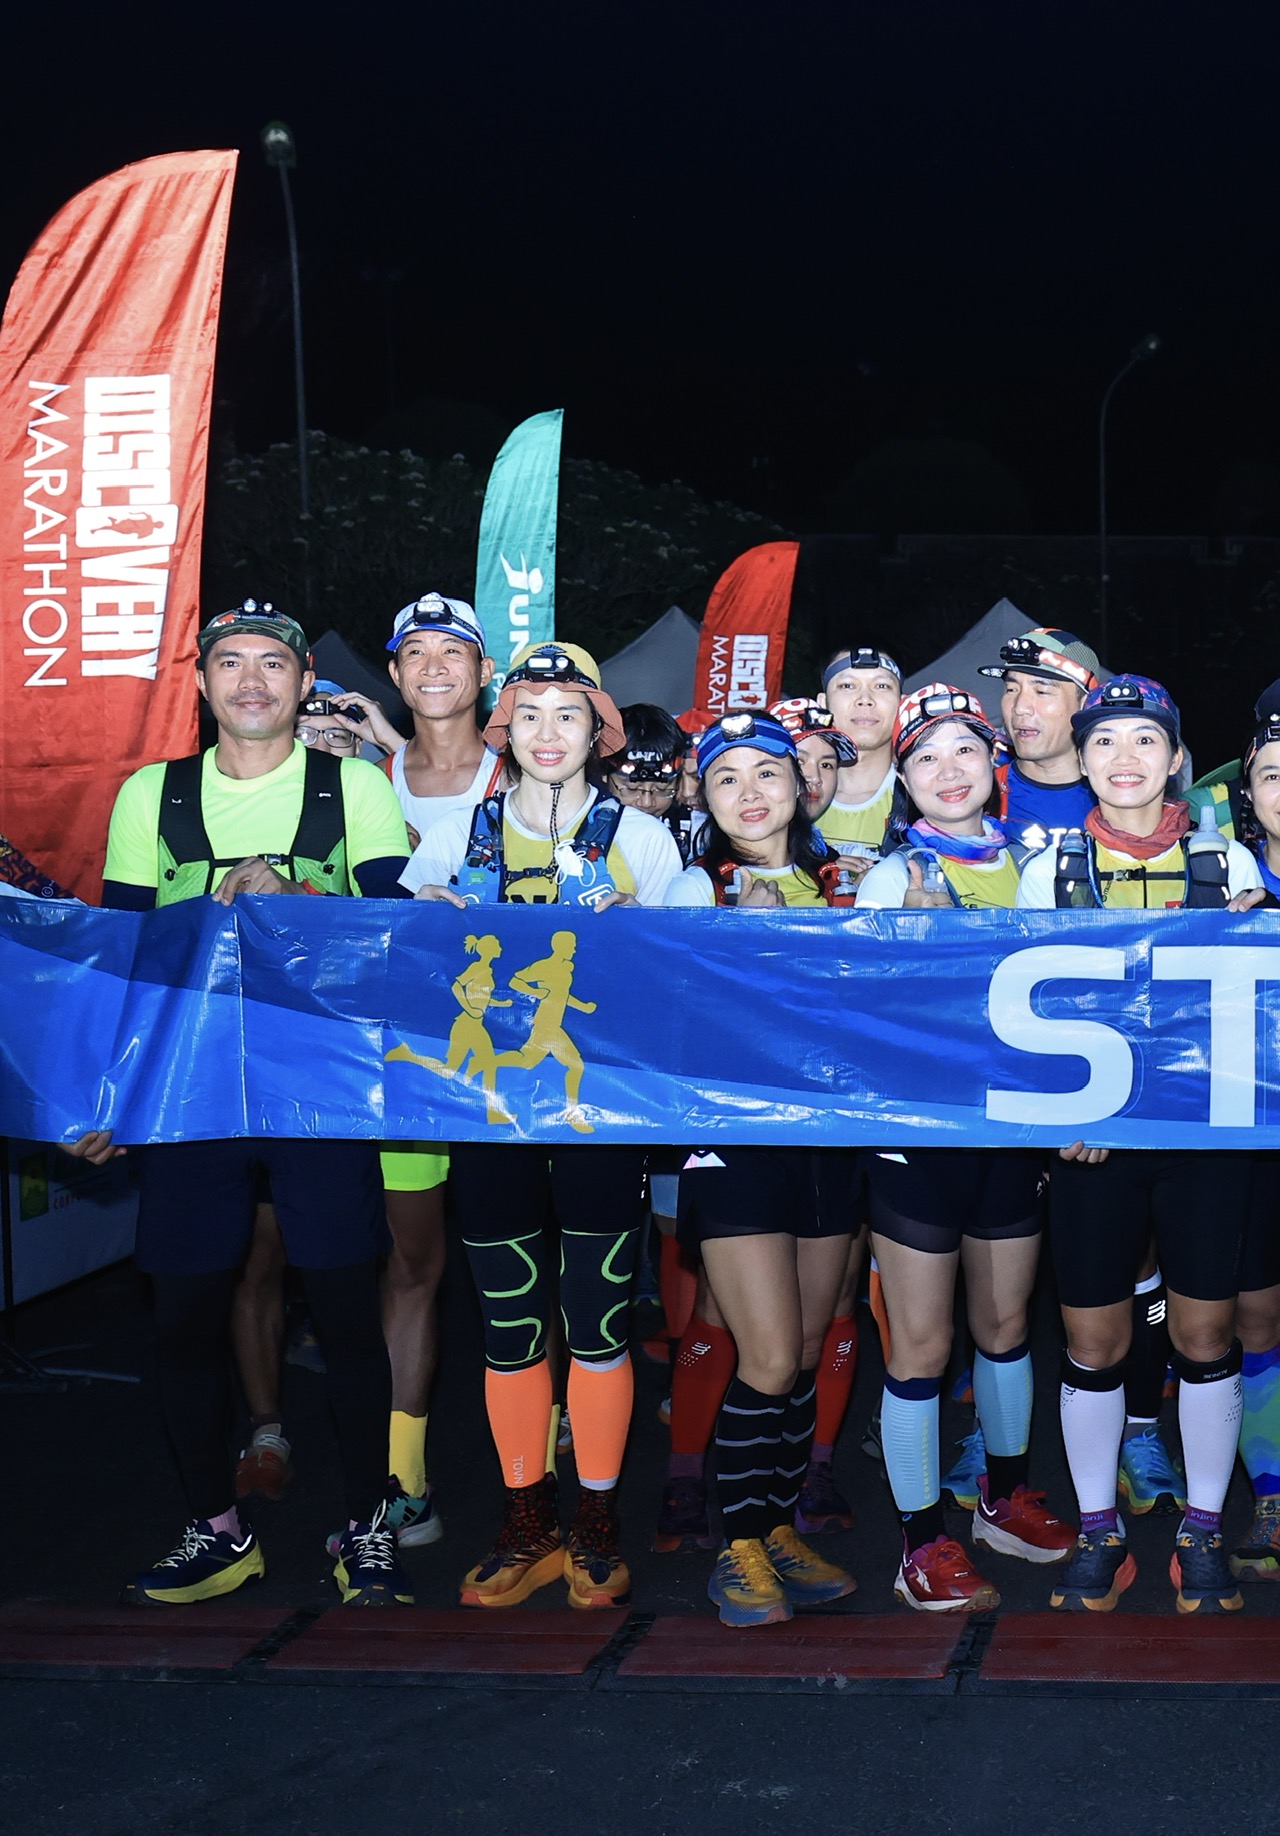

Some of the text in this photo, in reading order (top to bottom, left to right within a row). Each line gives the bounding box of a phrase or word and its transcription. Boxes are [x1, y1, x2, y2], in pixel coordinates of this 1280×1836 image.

[22, 380, 71, 687] MARATHON
[75, 374, 179, 681] DISCOVERY
[707, 635, 730, 718] MARAT
